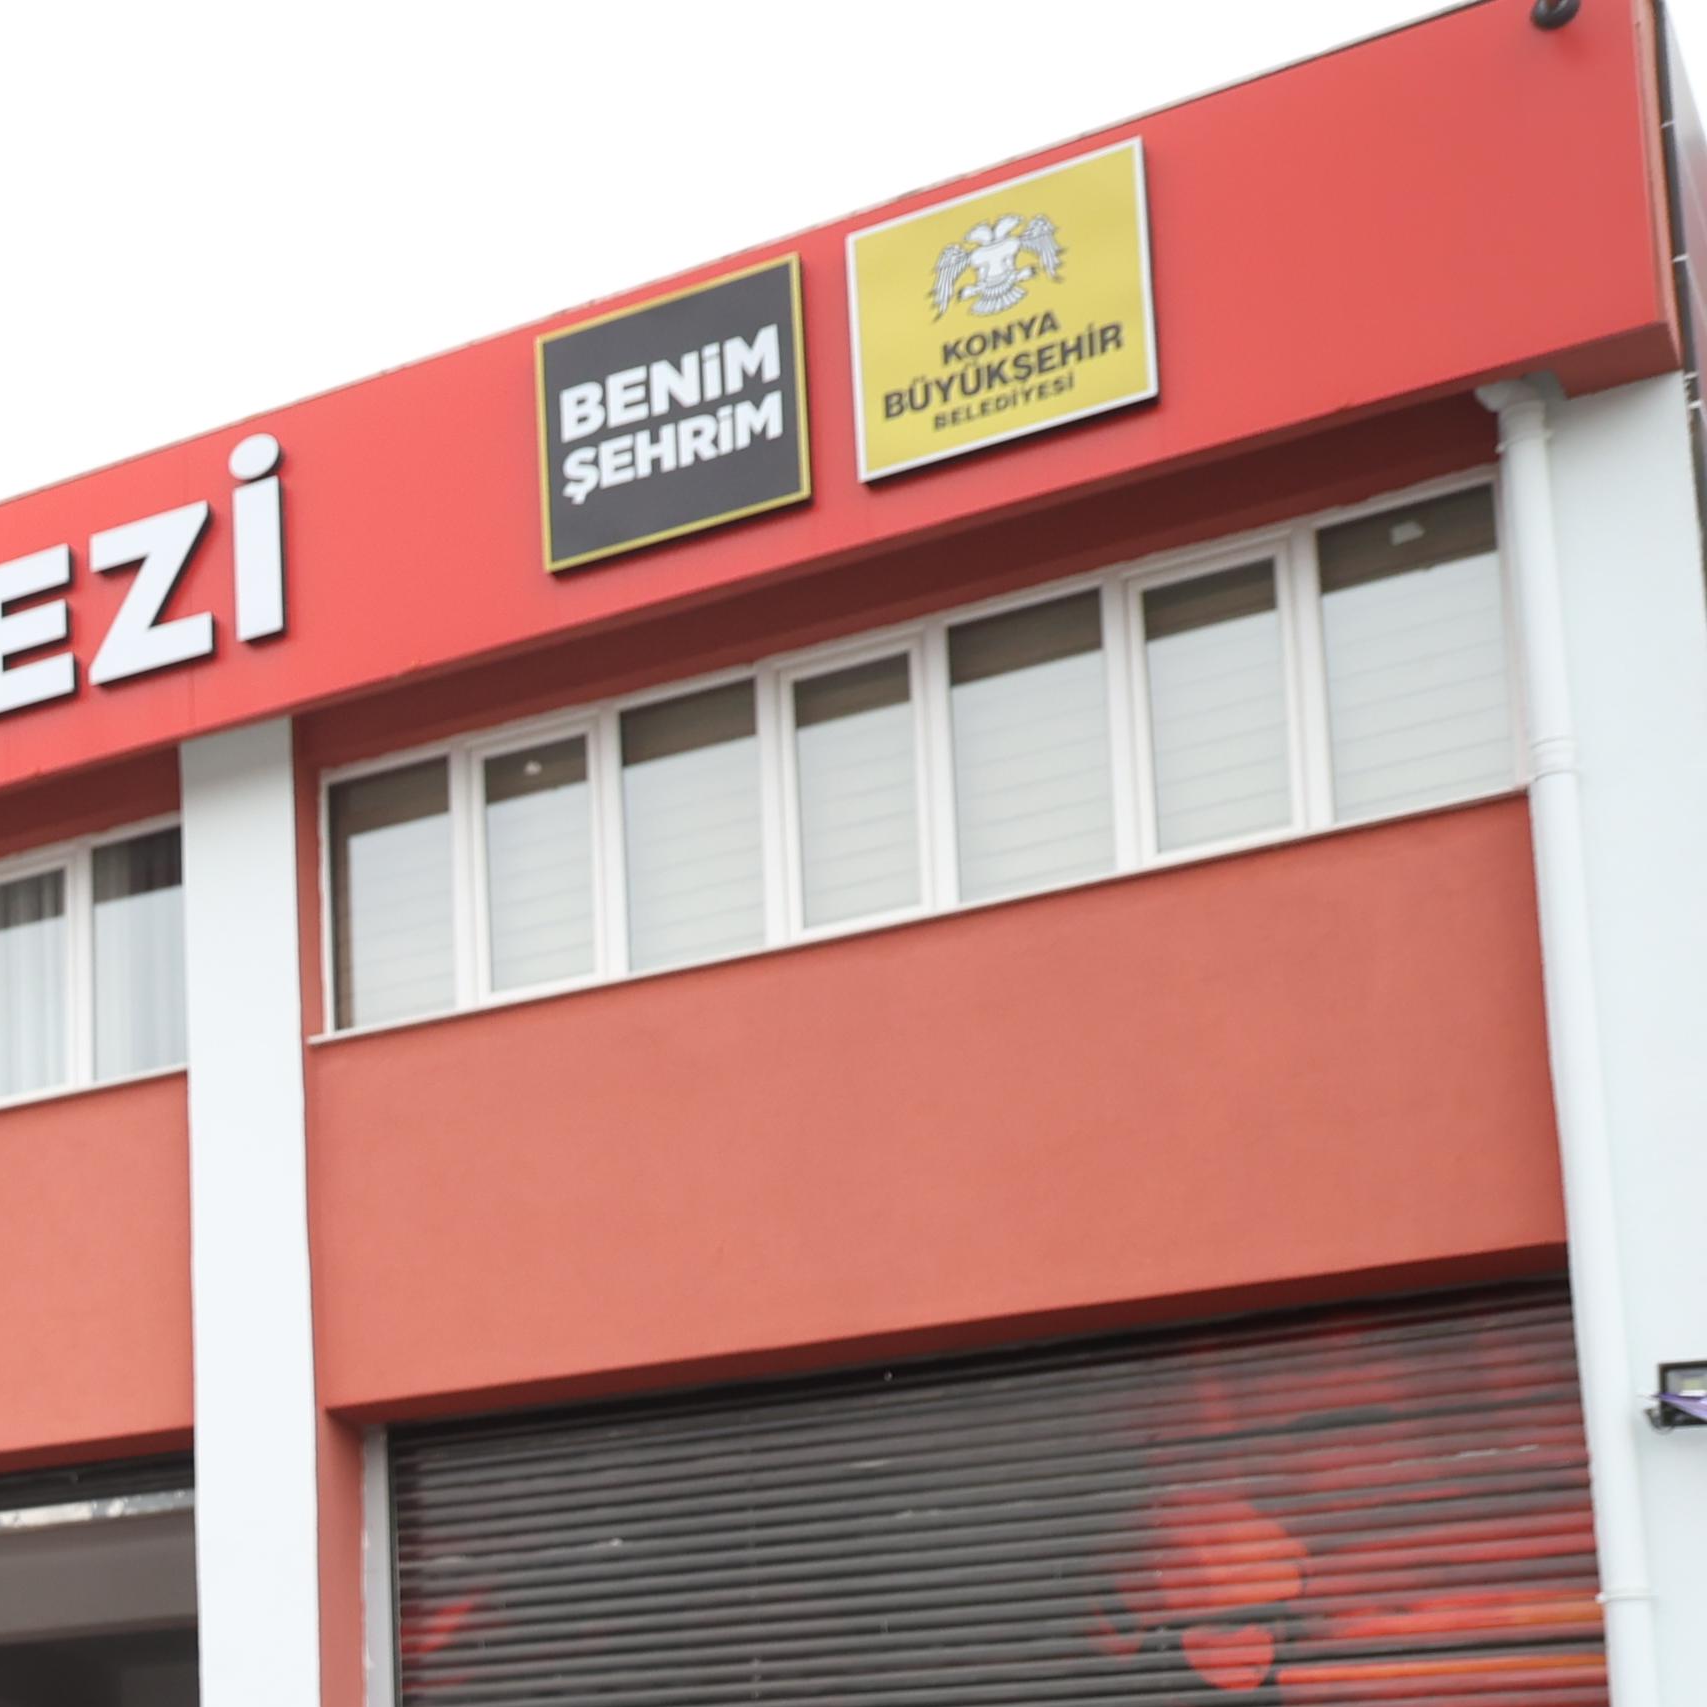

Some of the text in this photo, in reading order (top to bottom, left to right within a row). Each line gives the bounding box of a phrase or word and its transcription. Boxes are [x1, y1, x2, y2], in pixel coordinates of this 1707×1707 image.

[941, 312, 1058, 364] KONYA
[883, 323, 1124, 421] BÜYÜKŞEHİR
[933, 373, 1075, 431] BELEDİYESİ
